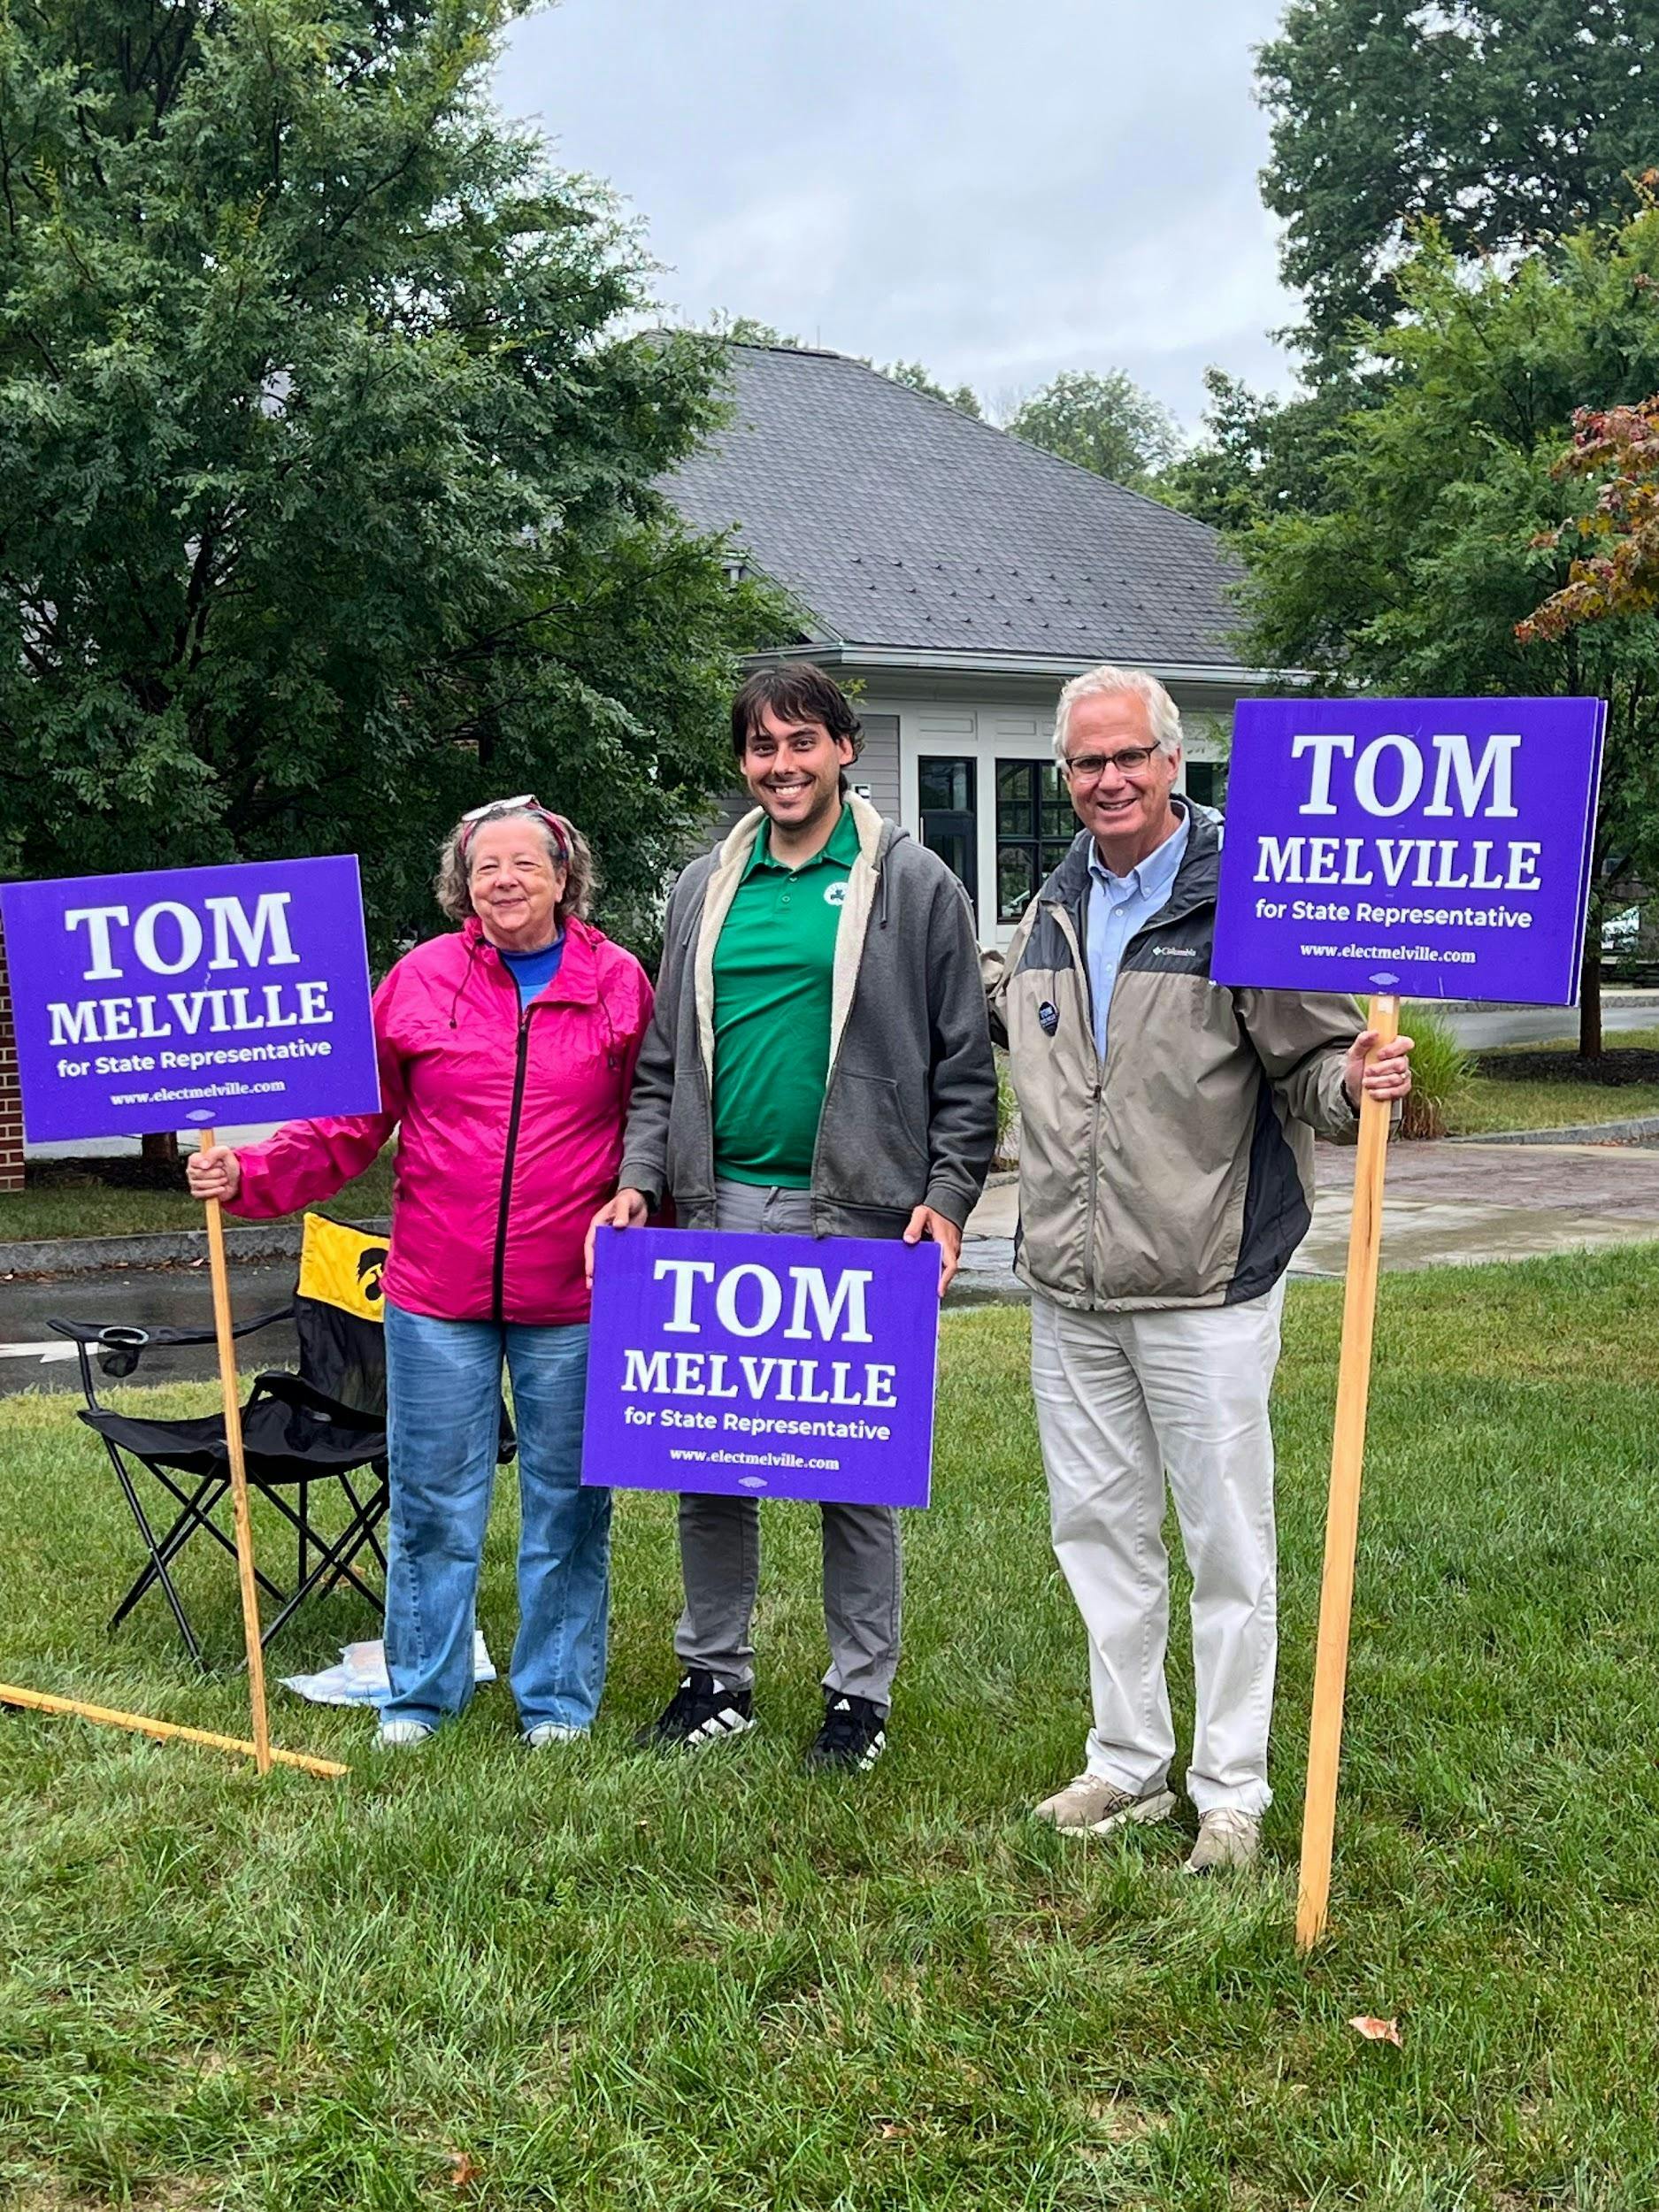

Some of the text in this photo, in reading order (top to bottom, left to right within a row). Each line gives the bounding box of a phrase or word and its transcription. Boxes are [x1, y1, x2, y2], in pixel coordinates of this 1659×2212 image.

[1291, 733, 1522, 818] TOM
[1252, 836, 1542, 891] MELVILLE
[65, 891, 301, 981] TOM
[1255, 898, 1532, 928] for State Representative
[1300, 943, 1476, 964] www.electmelville.com
[46, 980, 334, 1046] MELVILLE
[57, 1038, 332, 1078] for State Representative
[110, 1079, 286, 1105] www.electmelville.com
[653, 1259, 873, 1343] TOM
[620, 1349, 898, 1408] MELVILLE
[624, 1405, 891, 1440] for State Representative
[669, 1449, 840, 1471] www.electmelville.com
